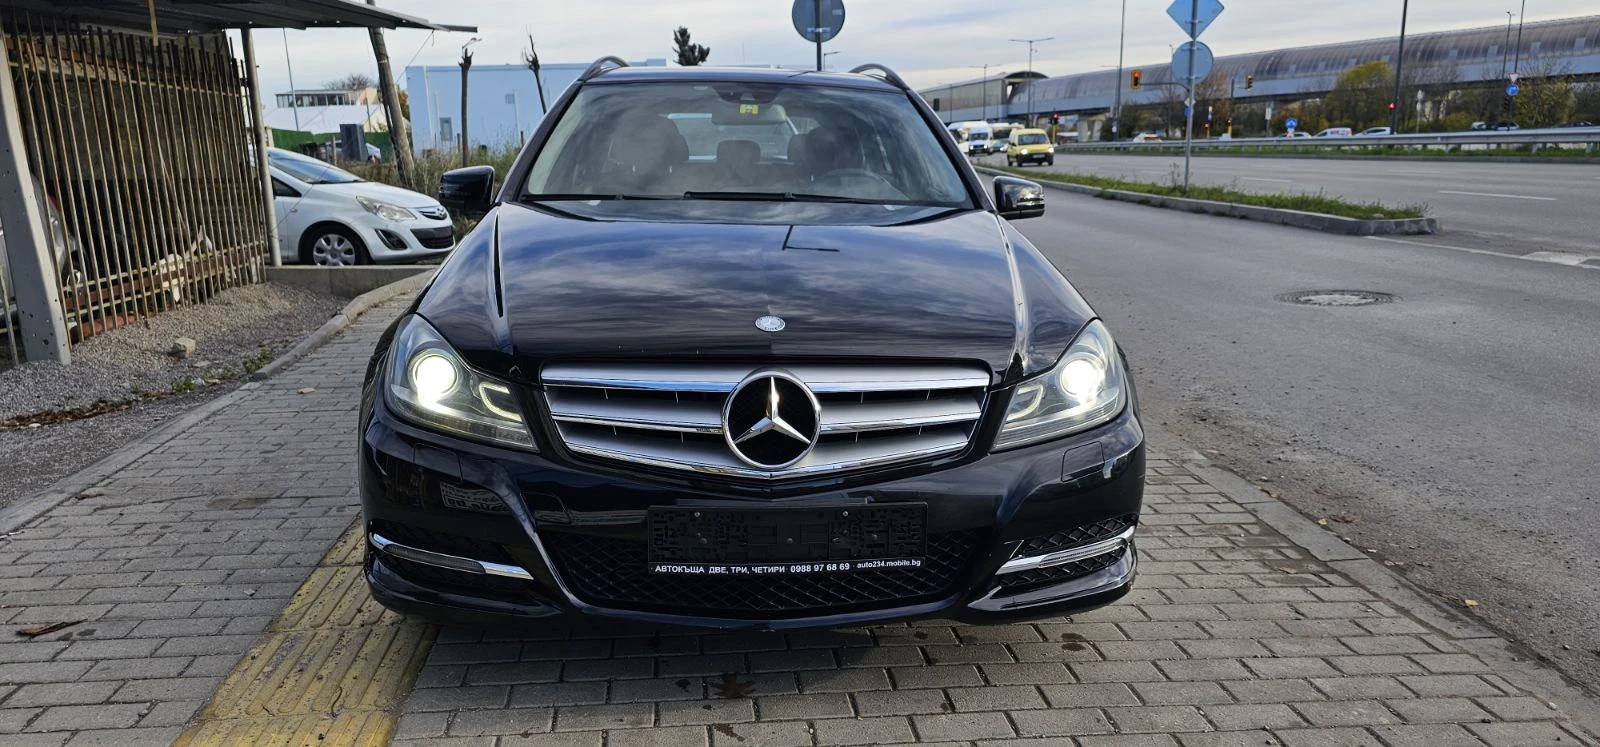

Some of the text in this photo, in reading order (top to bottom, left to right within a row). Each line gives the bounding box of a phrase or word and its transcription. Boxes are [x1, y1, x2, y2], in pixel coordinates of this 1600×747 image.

[655, 559, 921, 574] АВТОКЪЩА ДВЕ, ТРИ, ЧЕТИРИ 0988 97 68 69 auto234.mobile.bg
